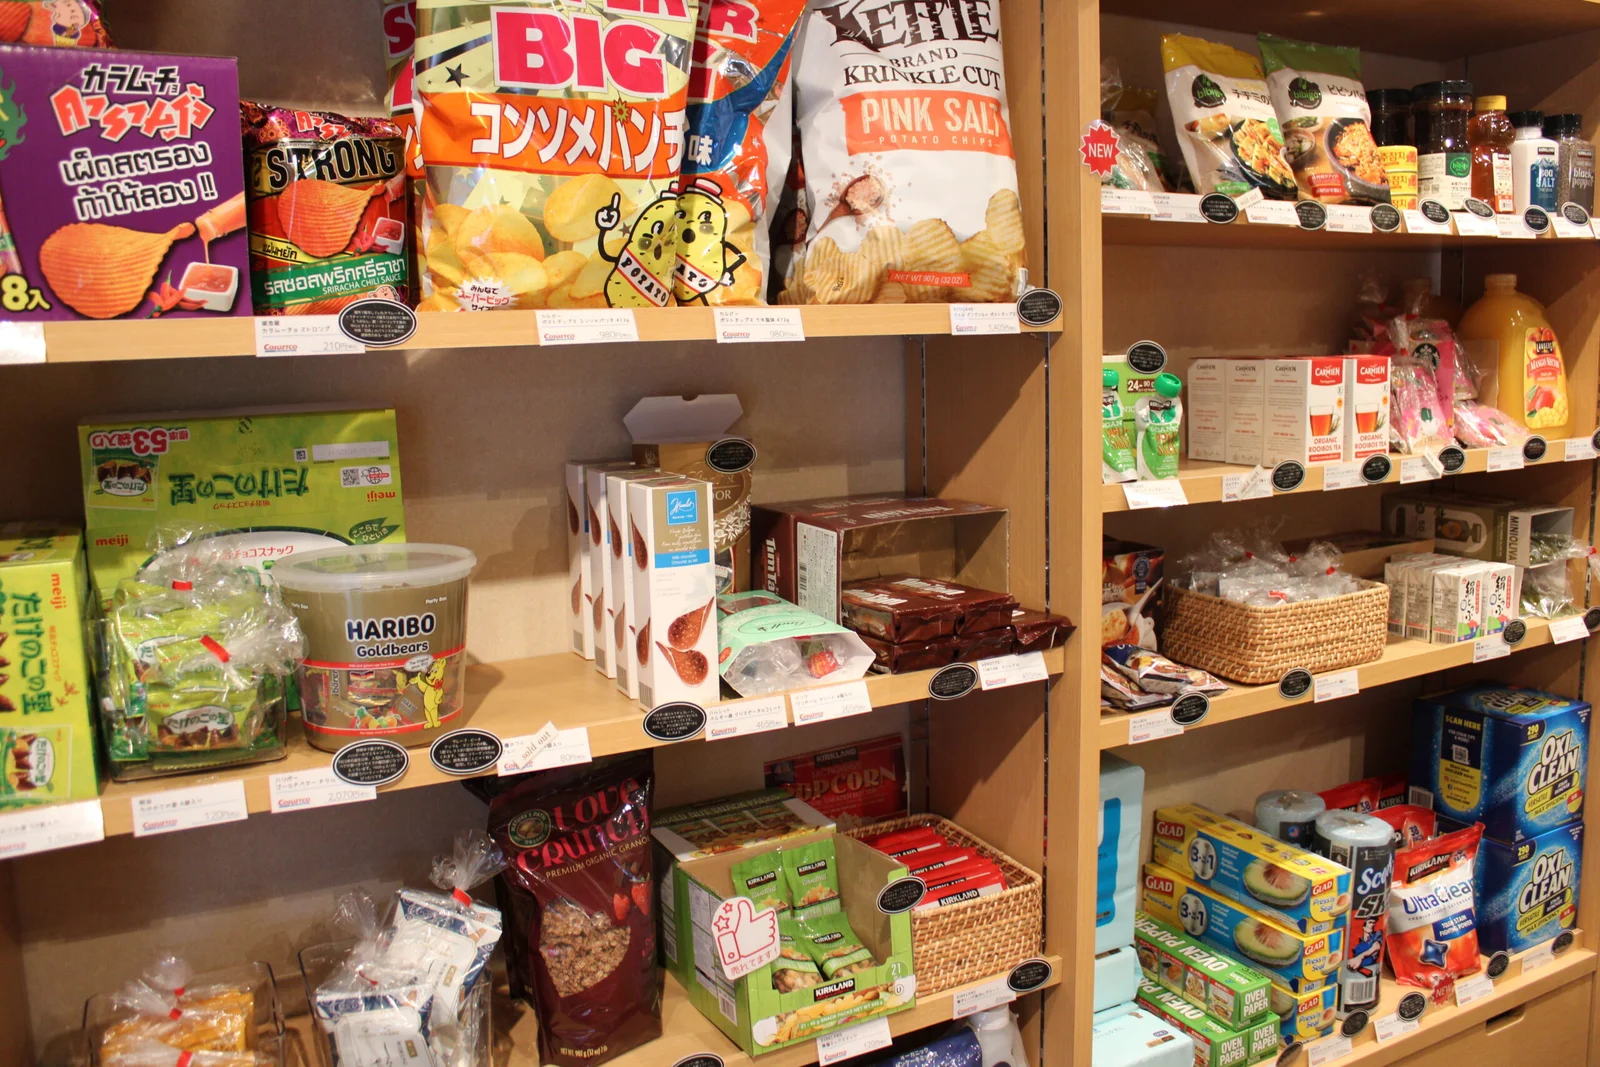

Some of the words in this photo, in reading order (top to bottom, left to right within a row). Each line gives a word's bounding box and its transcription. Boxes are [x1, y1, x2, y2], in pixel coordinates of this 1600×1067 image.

[495, 10, 666, 97] BIG
[890, 47, 958, 68] BRAND
[82, 63, 179, 95] カラムーチョ
[844, 65, 960, 87] KRINKLE
[963, 67, 1000, 91] CUT
[1294, 90, 1320, 102] bibigo
[862, 97, 934, 134] PINK
[946, 99, 1000, 137] SALT
[471, 102, 686, 173] コンソメパンチ
[879, 135, 940, 145] POTATO
[952, 137, 993, 148] CHIPS
[1088, 142, 1113, 158] NEW
[266, 138, 397, 190] STRONG
[1536, 178, 1554, 188] SALT
[322, 281, 360, 296] SRIRACHA
[361, 278, 380, 288] CHILI
[381, 274, 402, 284] SAUCE
[620, 257, 666, 302] POTATO
[923, 275, 938, 284] 907g
[470, 285, 498, 294] みんなで
[1314, 366, 1340, 378] CARMIEN
[1360, 366, 1386, 376] CARMIEN
[90, 430, 190, 456] 標準53袋入り
[1314, 436, 1338, 445] ORGANIC
[168, 467, 310, 506] たけのこの里
[366, 490, 396, 502] meiji
[212, 500, 270, 510] 明治チョコスナック
[352, 524, 379, 538] ここらで
[362, 528, 388, 542] ひといき
[95, 534, 129, 548] meiji
[51, 574, 66, 609] meiji
[346, 613, 436, 641] HARIBO
[12, 592, 54, 715] たけのこの里
[356, 641, 428, 658] Goldbears
[166, 712, 230, 730] たけのこの里
[1446, 715, 1463, 726] SCAN
[1464, 719, 1482, 731] HERE
[1527, 724, 1539, 736] 290
[522, 742, 536, 760] sold
[537, 732, 552, 745] out
[1542, 732, 1572, 766] OXI
[816, 748, 857, 762] KIRKLAND
[1528, 746, 1580, 796] CLEAN
[1534, 806, 1546, 816] MAX
[1156, 821, 1184, 837] GLAD
[1408, 825, 1418, 836] 38
[1518, 844, 1530, 856] 290
[546, 862, 585, 878] PREMIUM
[586, 848, 616, 866] ORGANIC
[799, 861, 826, 873] KIRKLAND
[1410, 855, 1450, 876] KIRKLAND
[1533, 850, 1564, 885] OXI
[748, 872, 775, 886] KIRKLAND
[1146, 876, 1173, 892] GLAD
[751, 886, 776, 898] Unsalted
[1312, 880, 1333, 896] GLAD
[1520, 863, 1572, 914] CLEAN
[940, 890, 978, 906] KIRKLAND
[1320, 904, 1334, 912] Seal
[1454, 914, 1467, 926] STAIN
[1459, 920, 1474, 931] POWER
[1136, 918, 1186, 948] PAPER
[1311, 924, 1322, 933] 140
[1526, 924, 1538, 933] MAX
[814, 932, 842, 944] KIRKLAND
[1304, 940, 1324, 955] GLAD
[730, 948, 778, 975] 売れてます！
[1178, 944, 1230, 972] OVEN
[892, 962, 902, 976] 21
[1312, 962, 1326, 972] Seal
[816, 980, 854, 997] KIRKLAND
[1304, 983, 1314, 992] 140
[1436, 984, 1451, 998] NEW
[1244, 987, 1266, 1005] OVEN
[1298, 996, 1318, 1012] GLAD
[1156, 991, 1206, 1019] OVEN
[1244, 998, 1268, 1016] PAPER
[820, 1014, 837, 1024] SNACK
[838, 1010, 853, 1020] PACKS
[853, 1006, 863, 1015] NET
[1306, 1020, 1320, 1028] Seal
[1254, 1024, 1275, 1042] OVEN
[1221, 1037, 1242, 1054] OVEN
[1252, 1035, 1278, 1054] PAPER
[1220, 1048, 1246, 1066] PAPER
